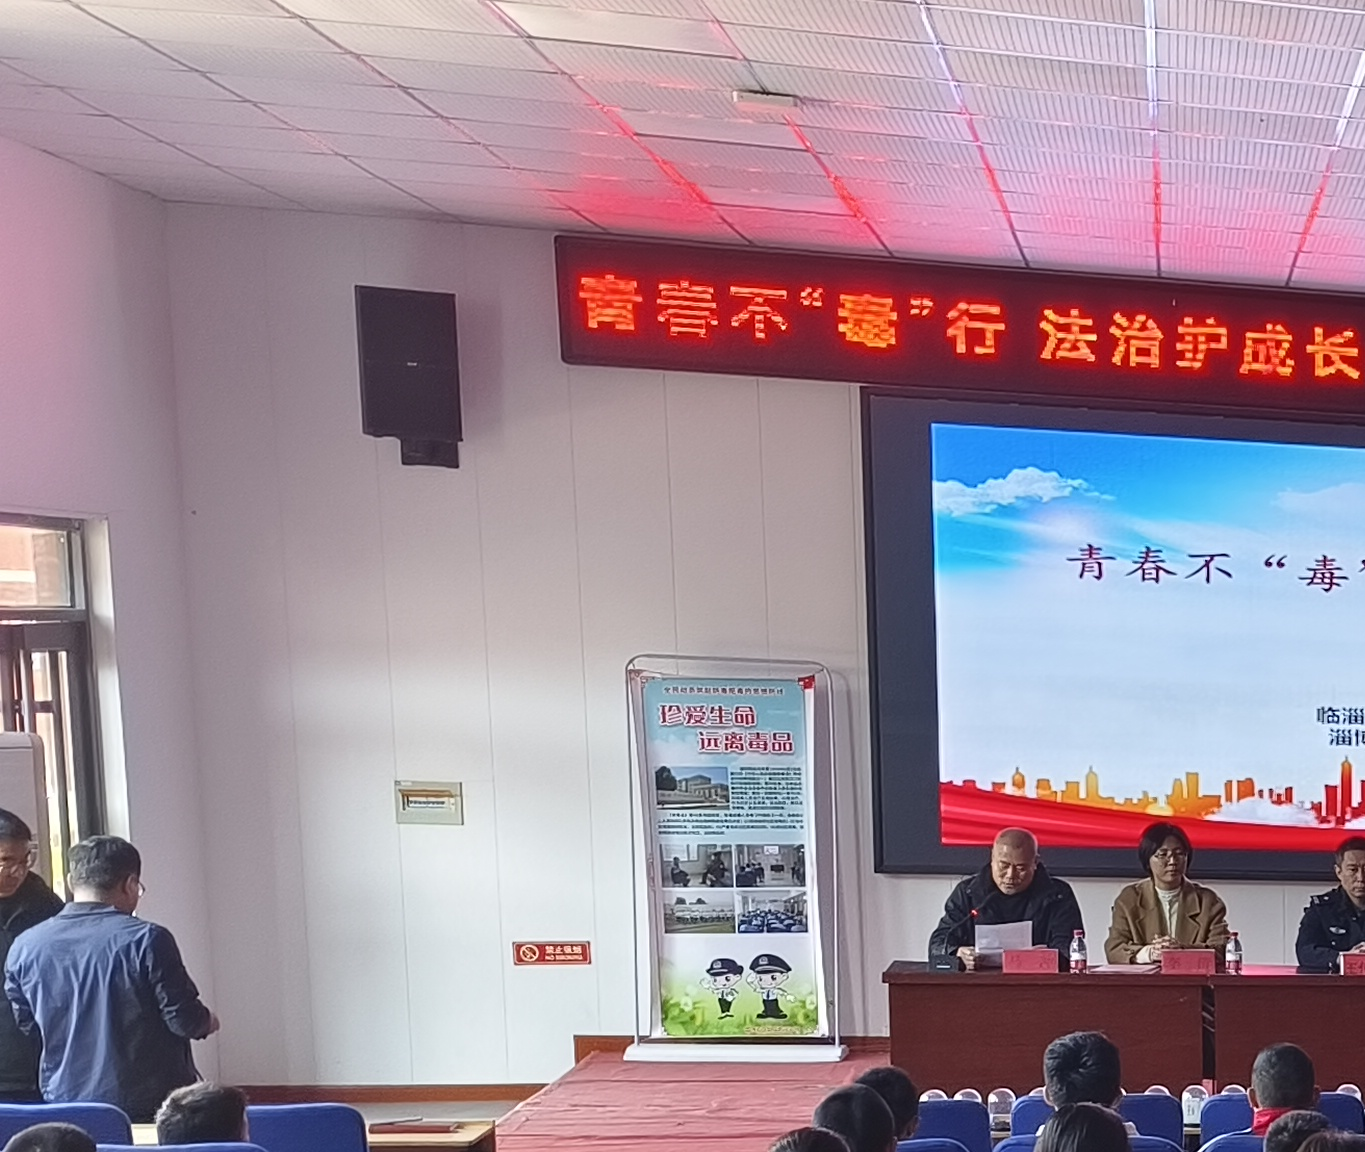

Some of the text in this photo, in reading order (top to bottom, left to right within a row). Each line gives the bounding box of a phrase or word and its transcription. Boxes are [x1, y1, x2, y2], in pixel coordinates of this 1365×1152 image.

[659, 703, 757, 727] 珍爱生命
[698, 730, 794, 754] 远离毒品
